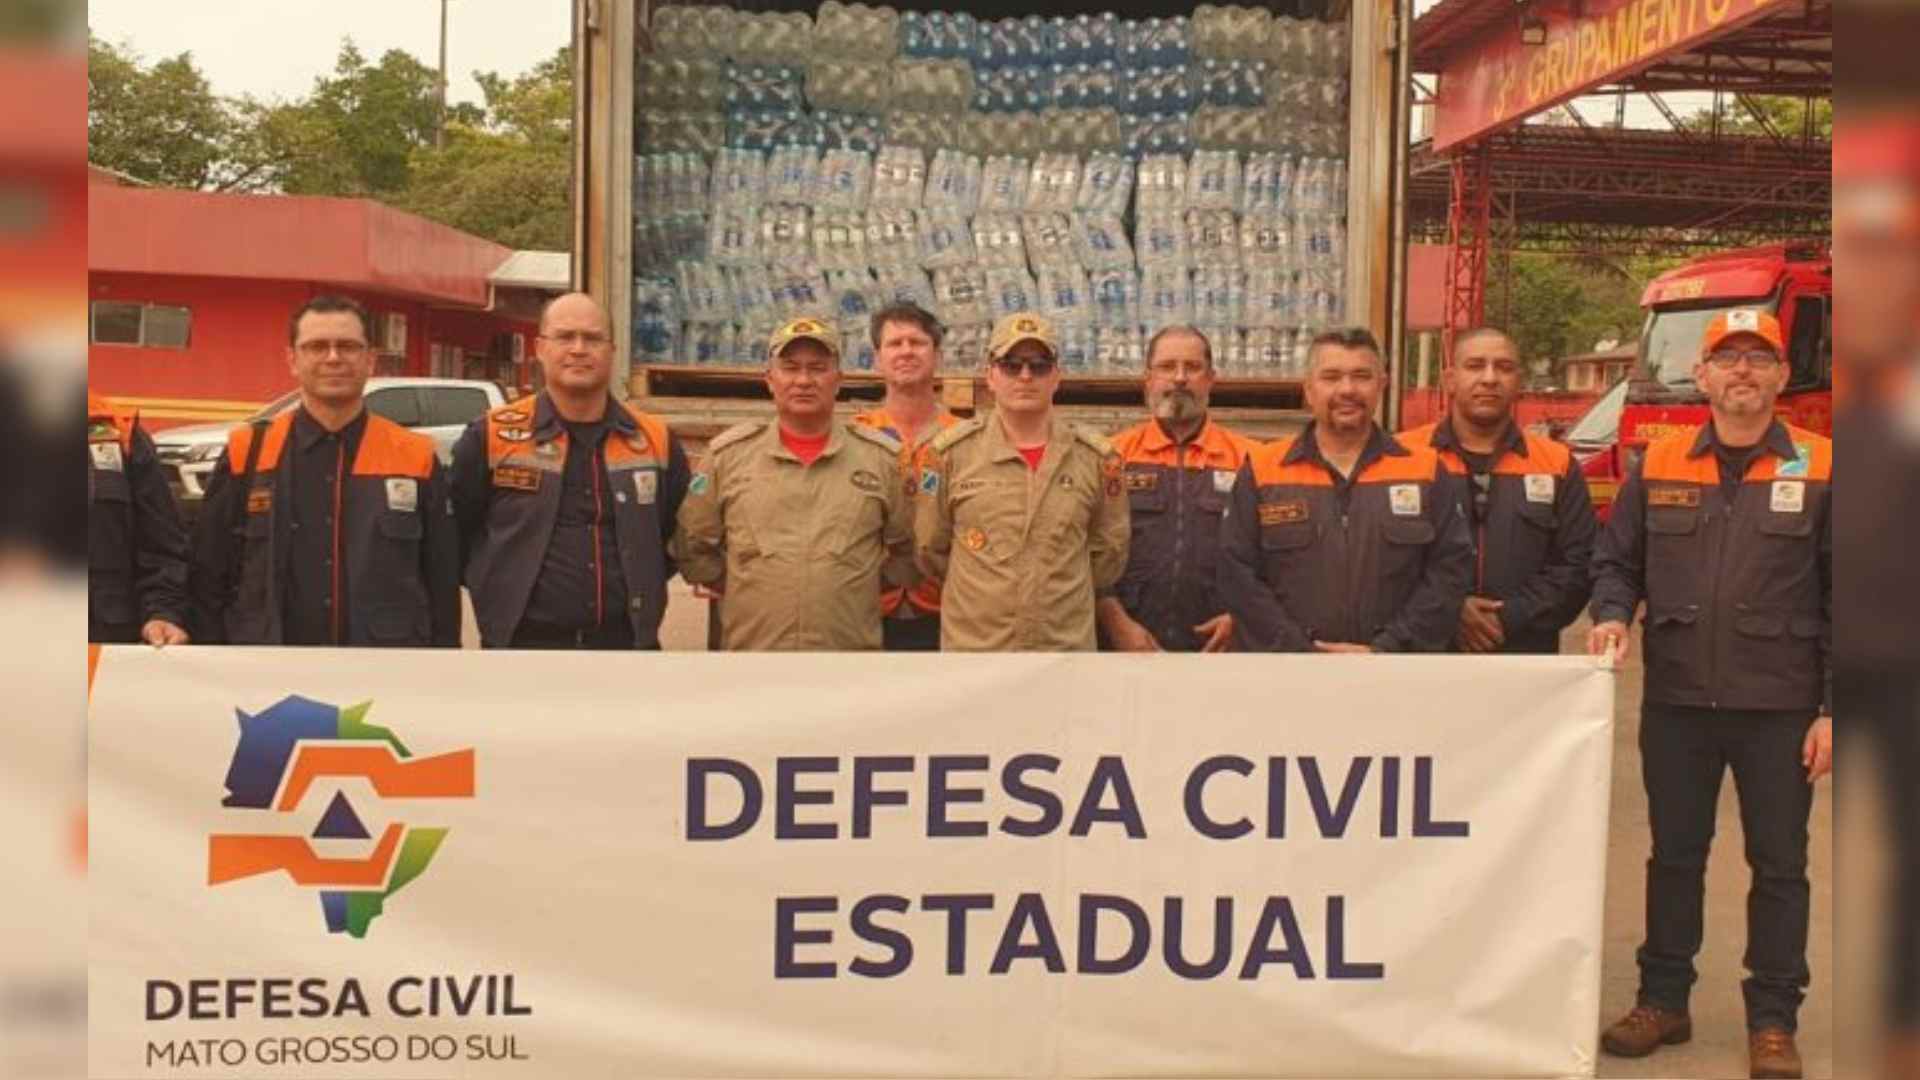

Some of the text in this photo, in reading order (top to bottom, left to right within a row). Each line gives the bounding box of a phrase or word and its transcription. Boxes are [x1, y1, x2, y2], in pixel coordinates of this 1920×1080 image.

[1528, 0, 1730, 102] GRUPAMENTO
[685, 753, 1470, 842] DEFESA CIVIL
[773, 892, 1385, 981] ESTADUAL
[145, 974, 532, 1021] DEFESA CIVIL
[145, 1034, 530, 1068] MATO GROSSO DO SUL
